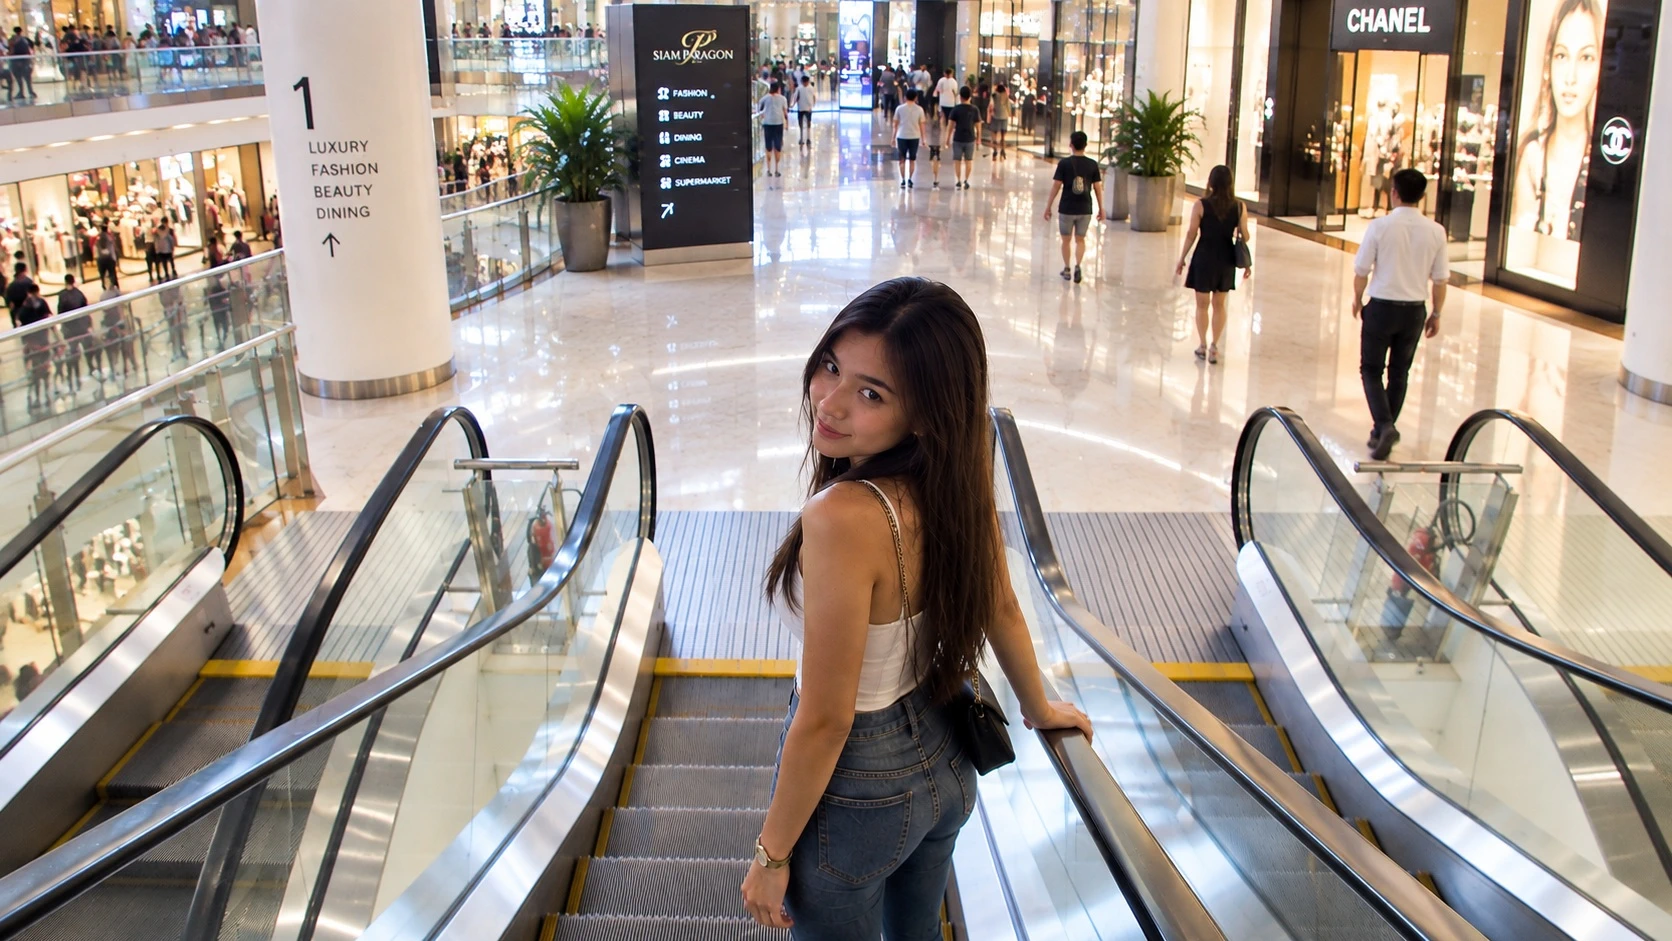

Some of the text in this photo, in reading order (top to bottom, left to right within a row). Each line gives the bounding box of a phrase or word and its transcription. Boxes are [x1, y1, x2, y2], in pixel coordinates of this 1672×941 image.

[1347, 7, 1431, 34] CHANEL
[653, 50, 681, 61] SIAM
[673, 89, 708, 98] FASHION
[293, 76, 315, 130] 1
[673, 110, 704, 120] BEAUTY
[674, 133, 703, 142] DINING
[308, 140, 369, 154] LUXURY
[674, 155, 706, 165] CINEMA
[311, 162, 379, 177] FASHION
[675, 176, 732, 187] SUPERMARKET
[314, 184, 373, 198] BEAUTY
[316, 205, 371, 220] DINING
